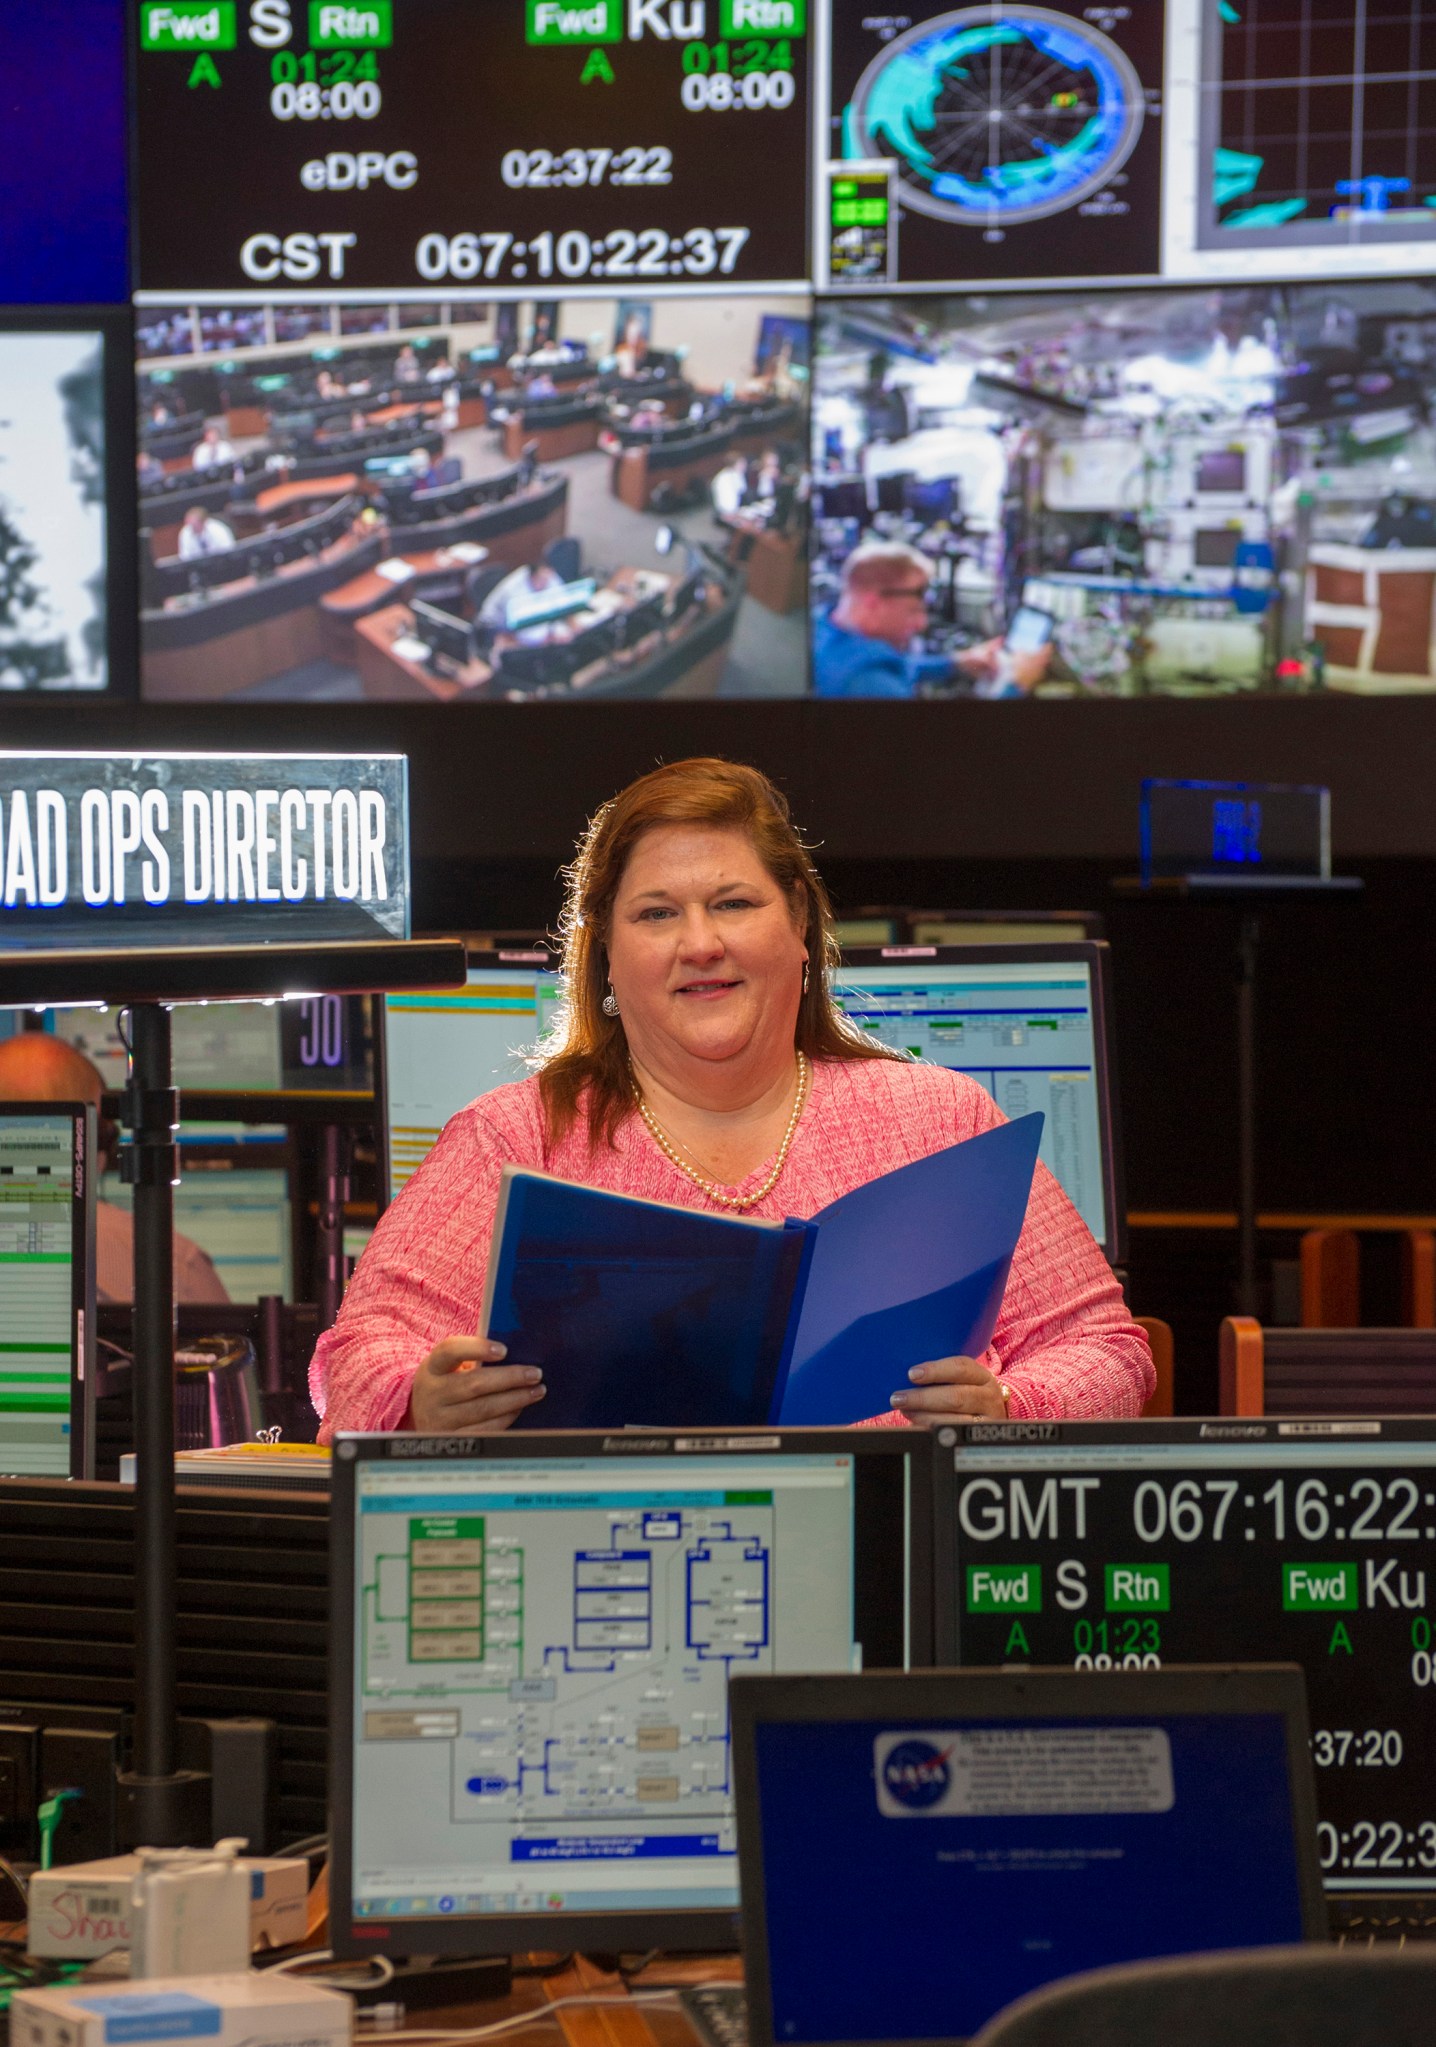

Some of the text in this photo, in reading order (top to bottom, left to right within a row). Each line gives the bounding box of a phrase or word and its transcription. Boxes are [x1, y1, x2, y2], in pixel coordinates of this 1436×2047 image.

[149, 0, 380, 47] Fwd S Rtn
[534, 0, 793, 40] Fwd Ku Rtn
[187, 51, 380, 89] A 01:24
[579, 41, 793, 84] A 01:24
[270, 81, 381, 119] 08:00
[681, 72, 795, 110] 08:00
[301, 147, 673, 190] eDPC 02:37:22
[239, 228, 750, 280] CST 067:10:22:37
[0, 788, 388, 905] AD OPS DIRECTOR
[959, 1478, 1100, 1540] GMT
[972, 1559, 1160, 1610] Fwd S Rtn
[1290, 1559, 1425, 1608] Fwd Ku
[1005, 1619, 1160, 1655] A 01:23
[1329, 1621, 1354, 1654] A
[1412, 1650, 1436, 1686] 0
[887, 1764, 945, 1783] NASA
